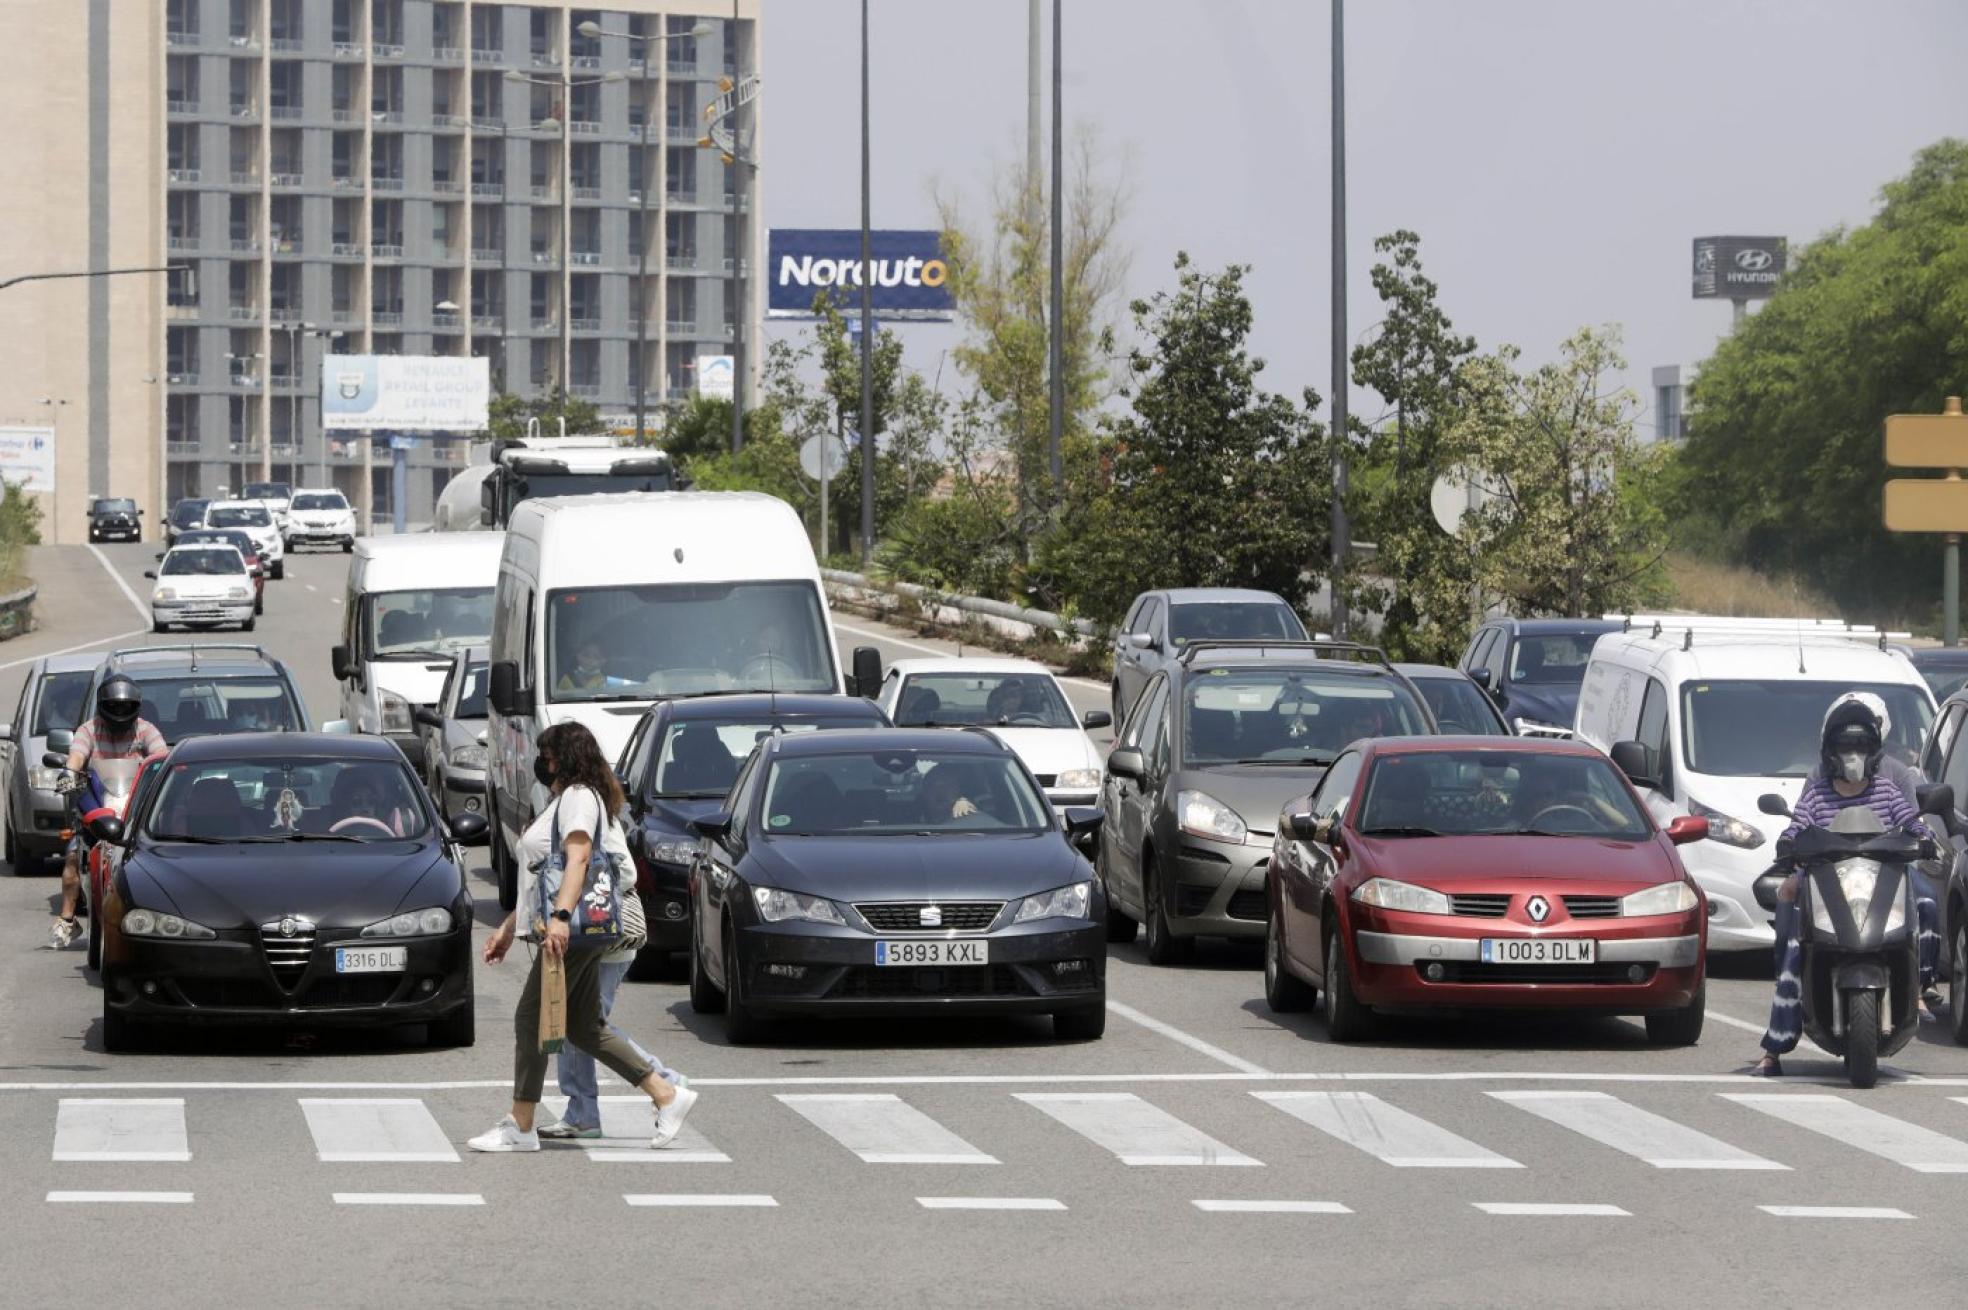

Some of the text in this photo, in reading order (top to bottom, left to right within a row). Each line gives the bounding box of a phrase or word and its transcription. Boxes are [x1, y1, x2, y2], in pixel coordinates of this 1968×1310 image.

[779, 255, 947, 287] Norauto
[434, 381, 482, 392] GROUP
[405, 397, 462, 408] LEVANTE
[889, 943, 983, 962] 5893 KXL
[1498, 942, 1590, 960] 1003 DLM
[345, 953, 376, 968] 3316
